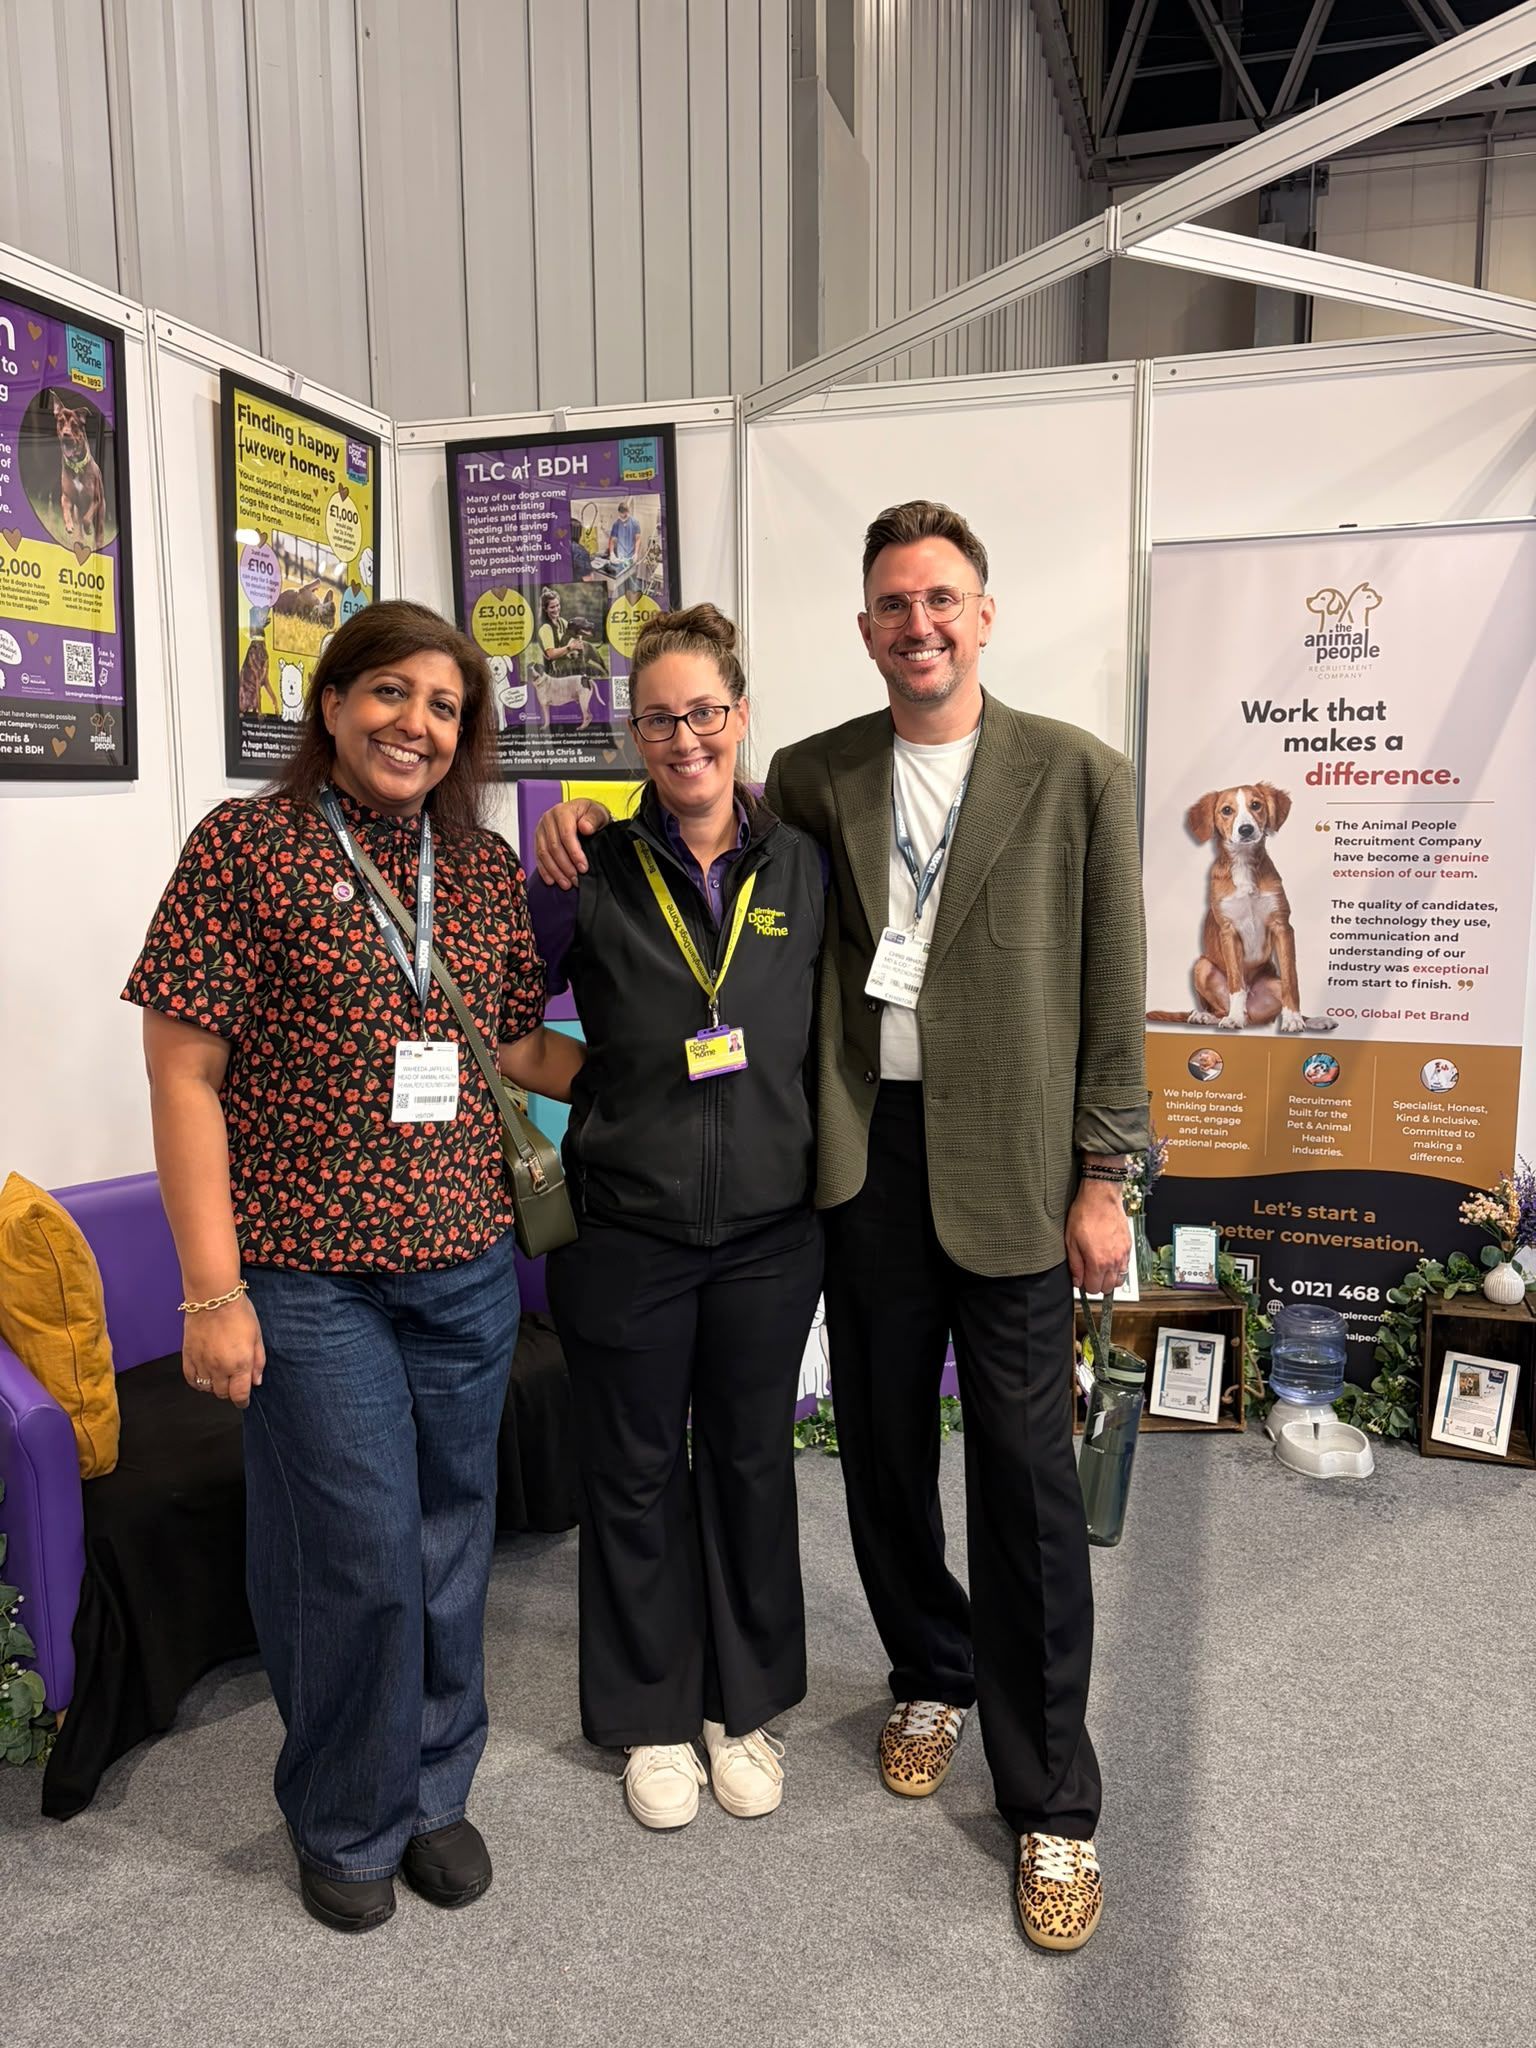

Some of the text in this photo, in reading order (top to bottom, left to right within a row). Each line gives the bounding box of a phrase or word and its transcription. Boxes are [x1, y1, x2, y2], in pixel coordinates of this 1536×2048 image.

[238, 403, 340, 464] Finding happy
[238, 426, 336, 484] furever homes
[465, 454, 588, 483] TLC at BDH
[238, 469, 314, 502] Your support gives lost,
[239, 481, 321, 515] homeless abandoned
[466, 494, 488, 504] Many
[491, 494, 500, 502] of
[518, 490, 540, 501] dogs
[542, 489, 567, 498] come
[466, 501, 545, 514] to us with existing
[330, 504, 358, 525] £1,000
[467, 511, 558, 526] injuries and illnesses,
[468, 522, 548, 537] needing life saving
[468, 532, 542, 546] and life changing
[469, 542, 552, 556] treatment, which is
[470, 552, 562, 568] only possible through
[248, 558, 274, 576] £100
[470, 564, 538, 578] your generosity.
[58, 568, 105, 591] £1,000
[478, 604, 526, 620] £3,000
[1335, 622, 1352, 633] the
[1304, 628, 1368, 648] animal
[1316, 640, 1380, 664] people
[1308, 664, 1373, 673] RECRUITMENT
[1317, 672, 1362, 680] COMPANY
[12, 710, 26, 718] have
[1241, 698, 1386, 724] Work that
[8, 720, 38, 730] Company's
[0, 732, 22, 743] Chris
[1284, 728, 1403, 752] makes a
[25, 745, 44, 754] BDH
[533, 756, 596, 766] everyone BDH
[1305, 762, 1460, 786] difference.
[1335, 820, 1457, 832] The Animal People
[1334, 836, 1482, 848] Recruitment Company
[1334, 852, 1364, 862] have
[1367, 852, 1420, 862] become
[1434, 852, 1490, 865] genuine
[1332, 868, 1478, 879] extension of our team.
[754, 907, 786, 918] Birmingham
[1331, 900, 1498, 912] The quality of candidates,
[748, 912, 776, 926] Dogs
[1330, 915, 1491, 928] the technology they use,
[679, 928, 691, 949] Dogs
[1330, 931, 1459, 942] communication and
[1328, 946, 1466, 960] understanding of our
[1328, 961, 1489, 976] industry was exceptional
[1327, 976, 1452, 990] from start to finish.
[1326, 1008, 1470, 1022] COO, Global Pet Brand
[1163, 1088, 1247, 1101] We help forward-
[1288, 1095, 1352, 1107] Recruitment
[1166, 1102, 1243, 1113] thinking brands
[1289, 1108, 1348, 1119] built for the
[1392, 1100, 1488, 1114] Specialist, Honest,
[1168, 1114, 1242, 1126] attract, engage
[1287, 1120, 1352, 1132] Pet & Animal
[1396, 1114, 1481, 1126] Kind & Inclusive.
[1178, 1126, 1228, 1137] and retain
[1402, 1126, 1476, 1139] Committed to
[1302, 1134, 1336, 1144] Health
[1214, 1141, 1250, 1152] people.
[1292, 1145, 1344, 1157] industries.
[1414, 1141, 1454, 1152] making
[1409, 1152, 1465, 1164] difference.
[1254, 1200, 1376, 1224] Let's start a
[1212, 1220, 1425, 1254] better conversation.
[1290, 1280, 1332, 1298] 0121
[1338, 1284, 1380, 1302] 468
